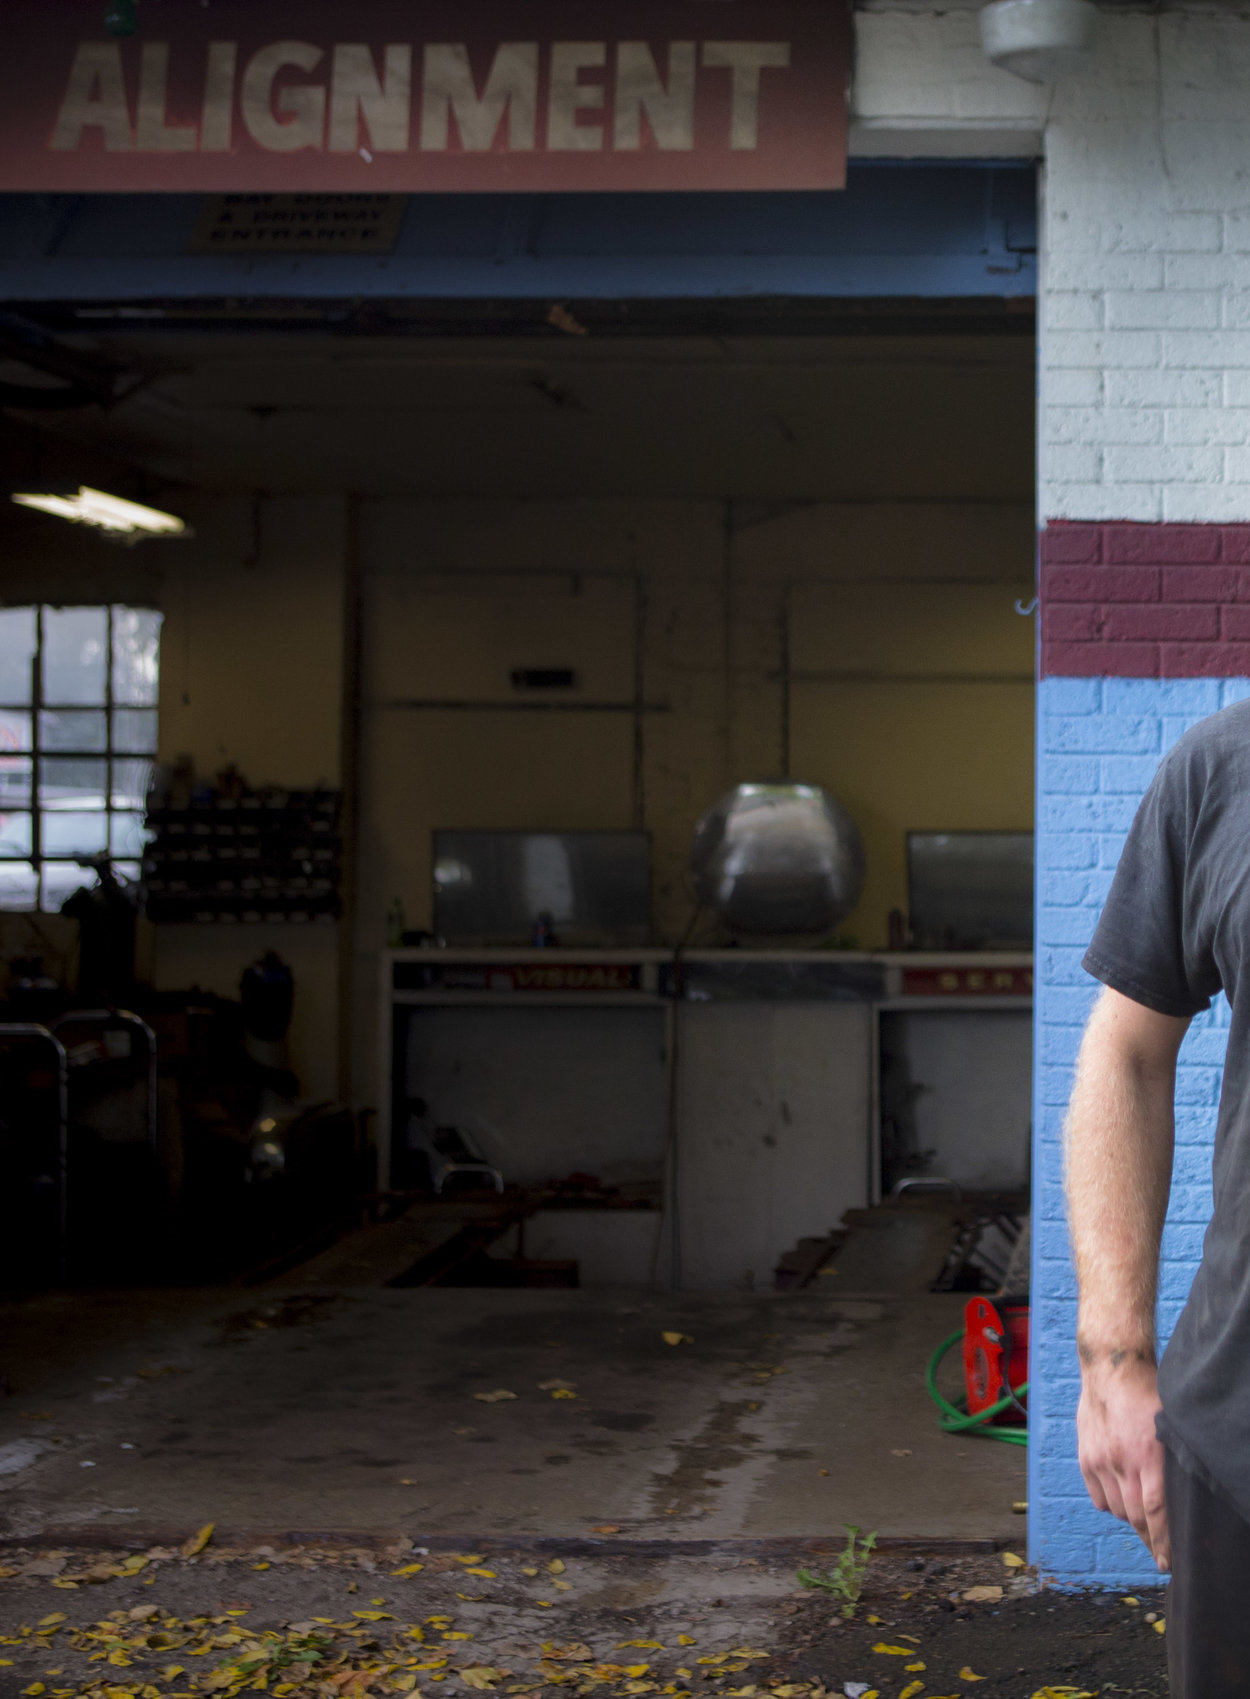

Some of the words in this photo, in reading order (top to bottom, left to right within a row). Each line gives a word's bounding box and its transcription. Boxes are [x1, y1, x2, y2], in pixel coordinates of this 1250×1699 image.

[49, 40, 790, 152] ALIGNMENT
[253, 209, 382, 223] DRIVEWAY
[210, 228, 378, 241] ENTRANCE
